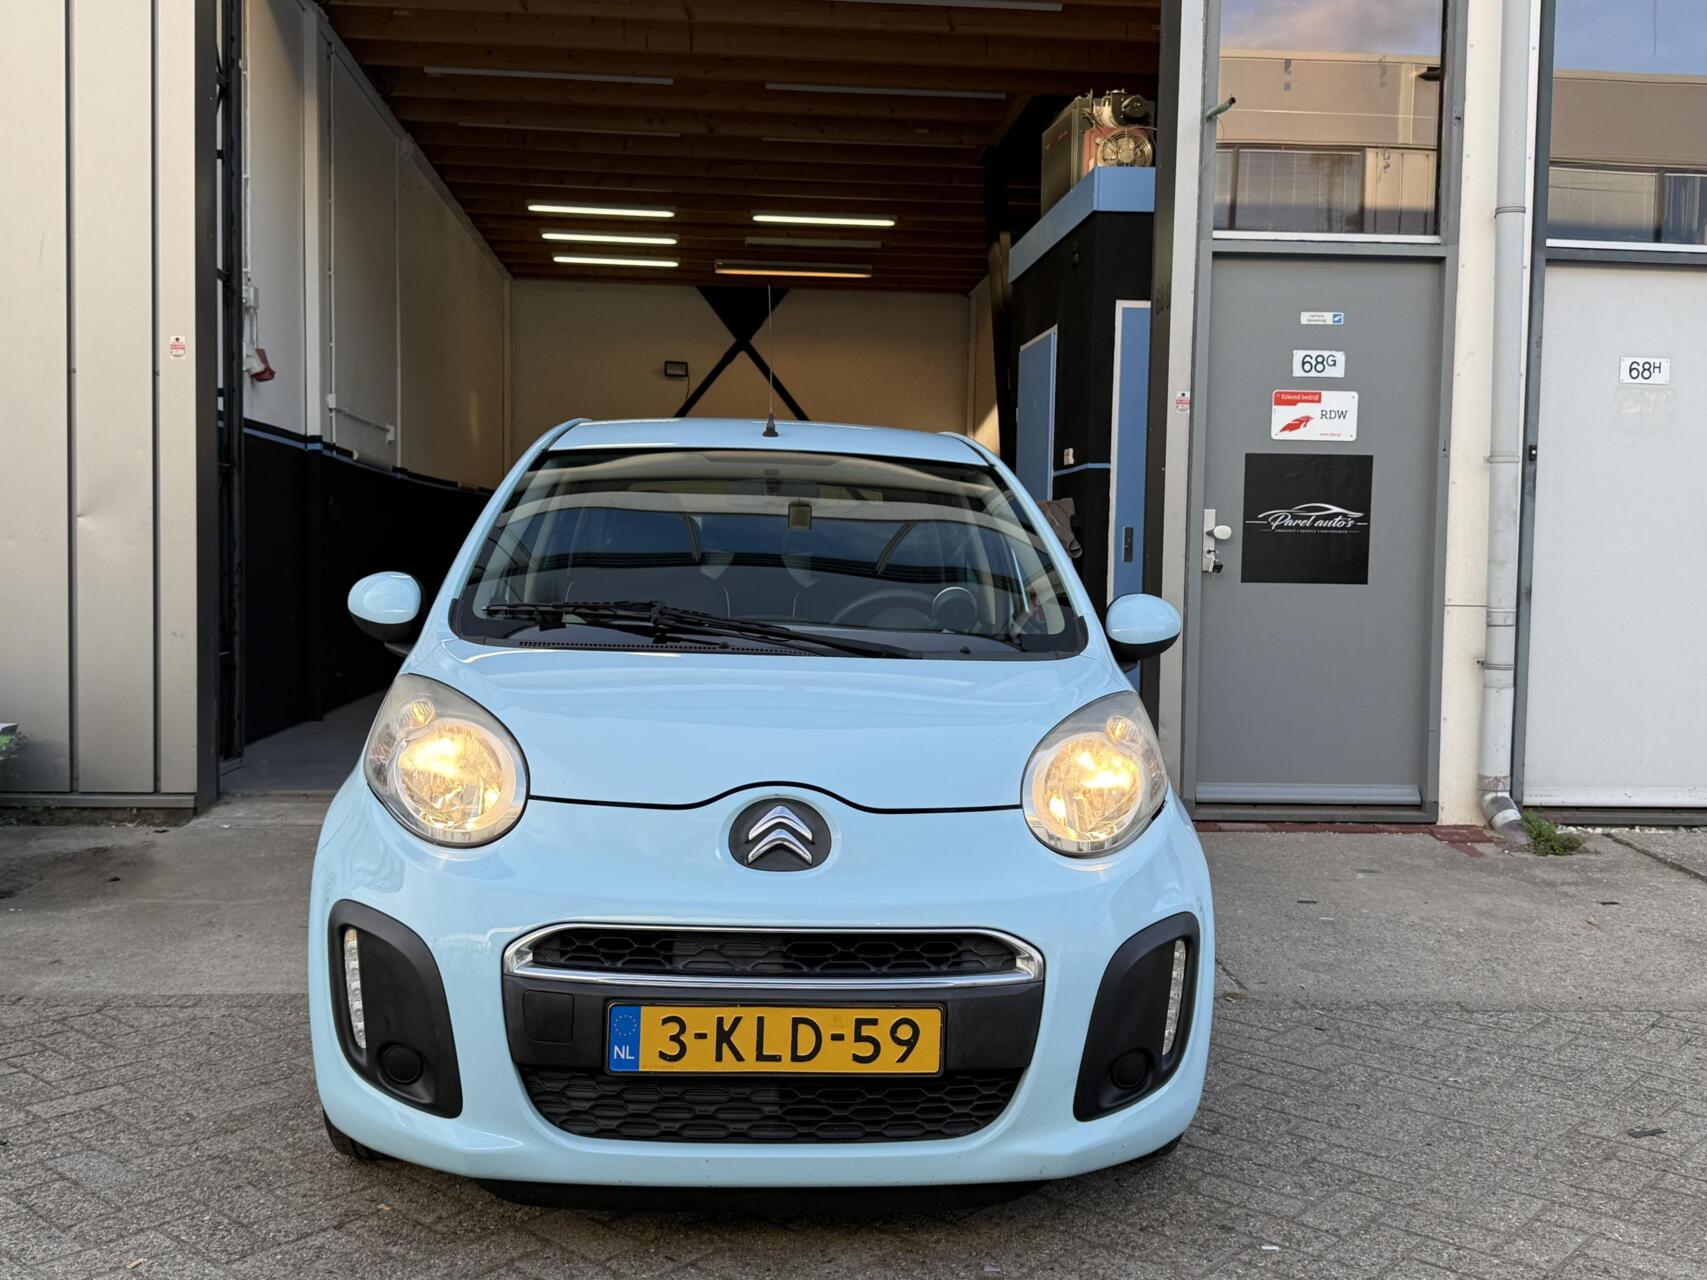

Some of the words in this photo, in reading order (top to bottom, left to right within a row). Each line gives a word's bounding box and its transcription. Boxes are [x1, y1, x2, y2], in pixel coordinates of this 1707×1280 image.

[1301, 354, 1337, 373] 68G
[1628, 360, 1662, 380] 68H
[1320, 409, 1348, 420] RDW
[1268, 512, 1316, 530] Parel
[658, 1015, 921, 1064] 3-KLD-59
[613, 1045, 635, 1060] NL
